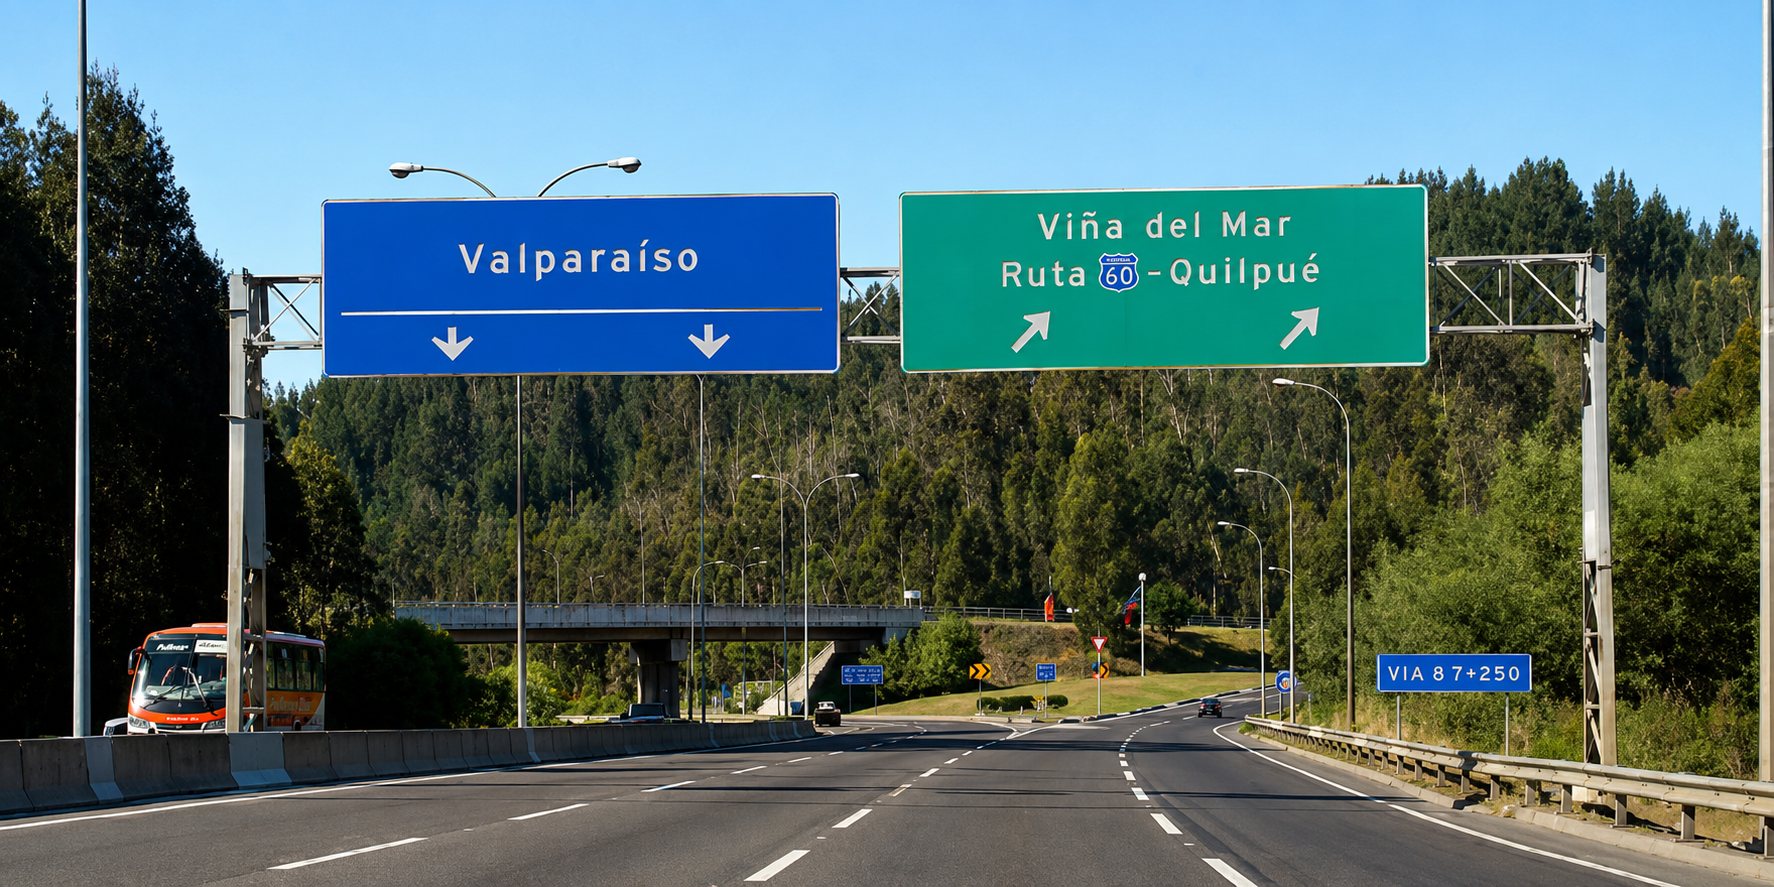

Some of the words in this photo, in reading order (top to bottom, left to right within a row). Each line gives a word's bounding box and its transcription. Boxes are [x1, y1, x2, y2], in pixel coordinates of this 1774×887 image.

[1037, 211, 1123, 240] Viña
[1145, 211, 1200, 239] del
[1222, 210, 1291, 237] Mar
[458, 239, 698, 282] Valparaíso
[1002, 260, 1085, 288] Ruta
[1105, 265, 1133, 286] 60
[1387, 665, 1424, 682] VIA
